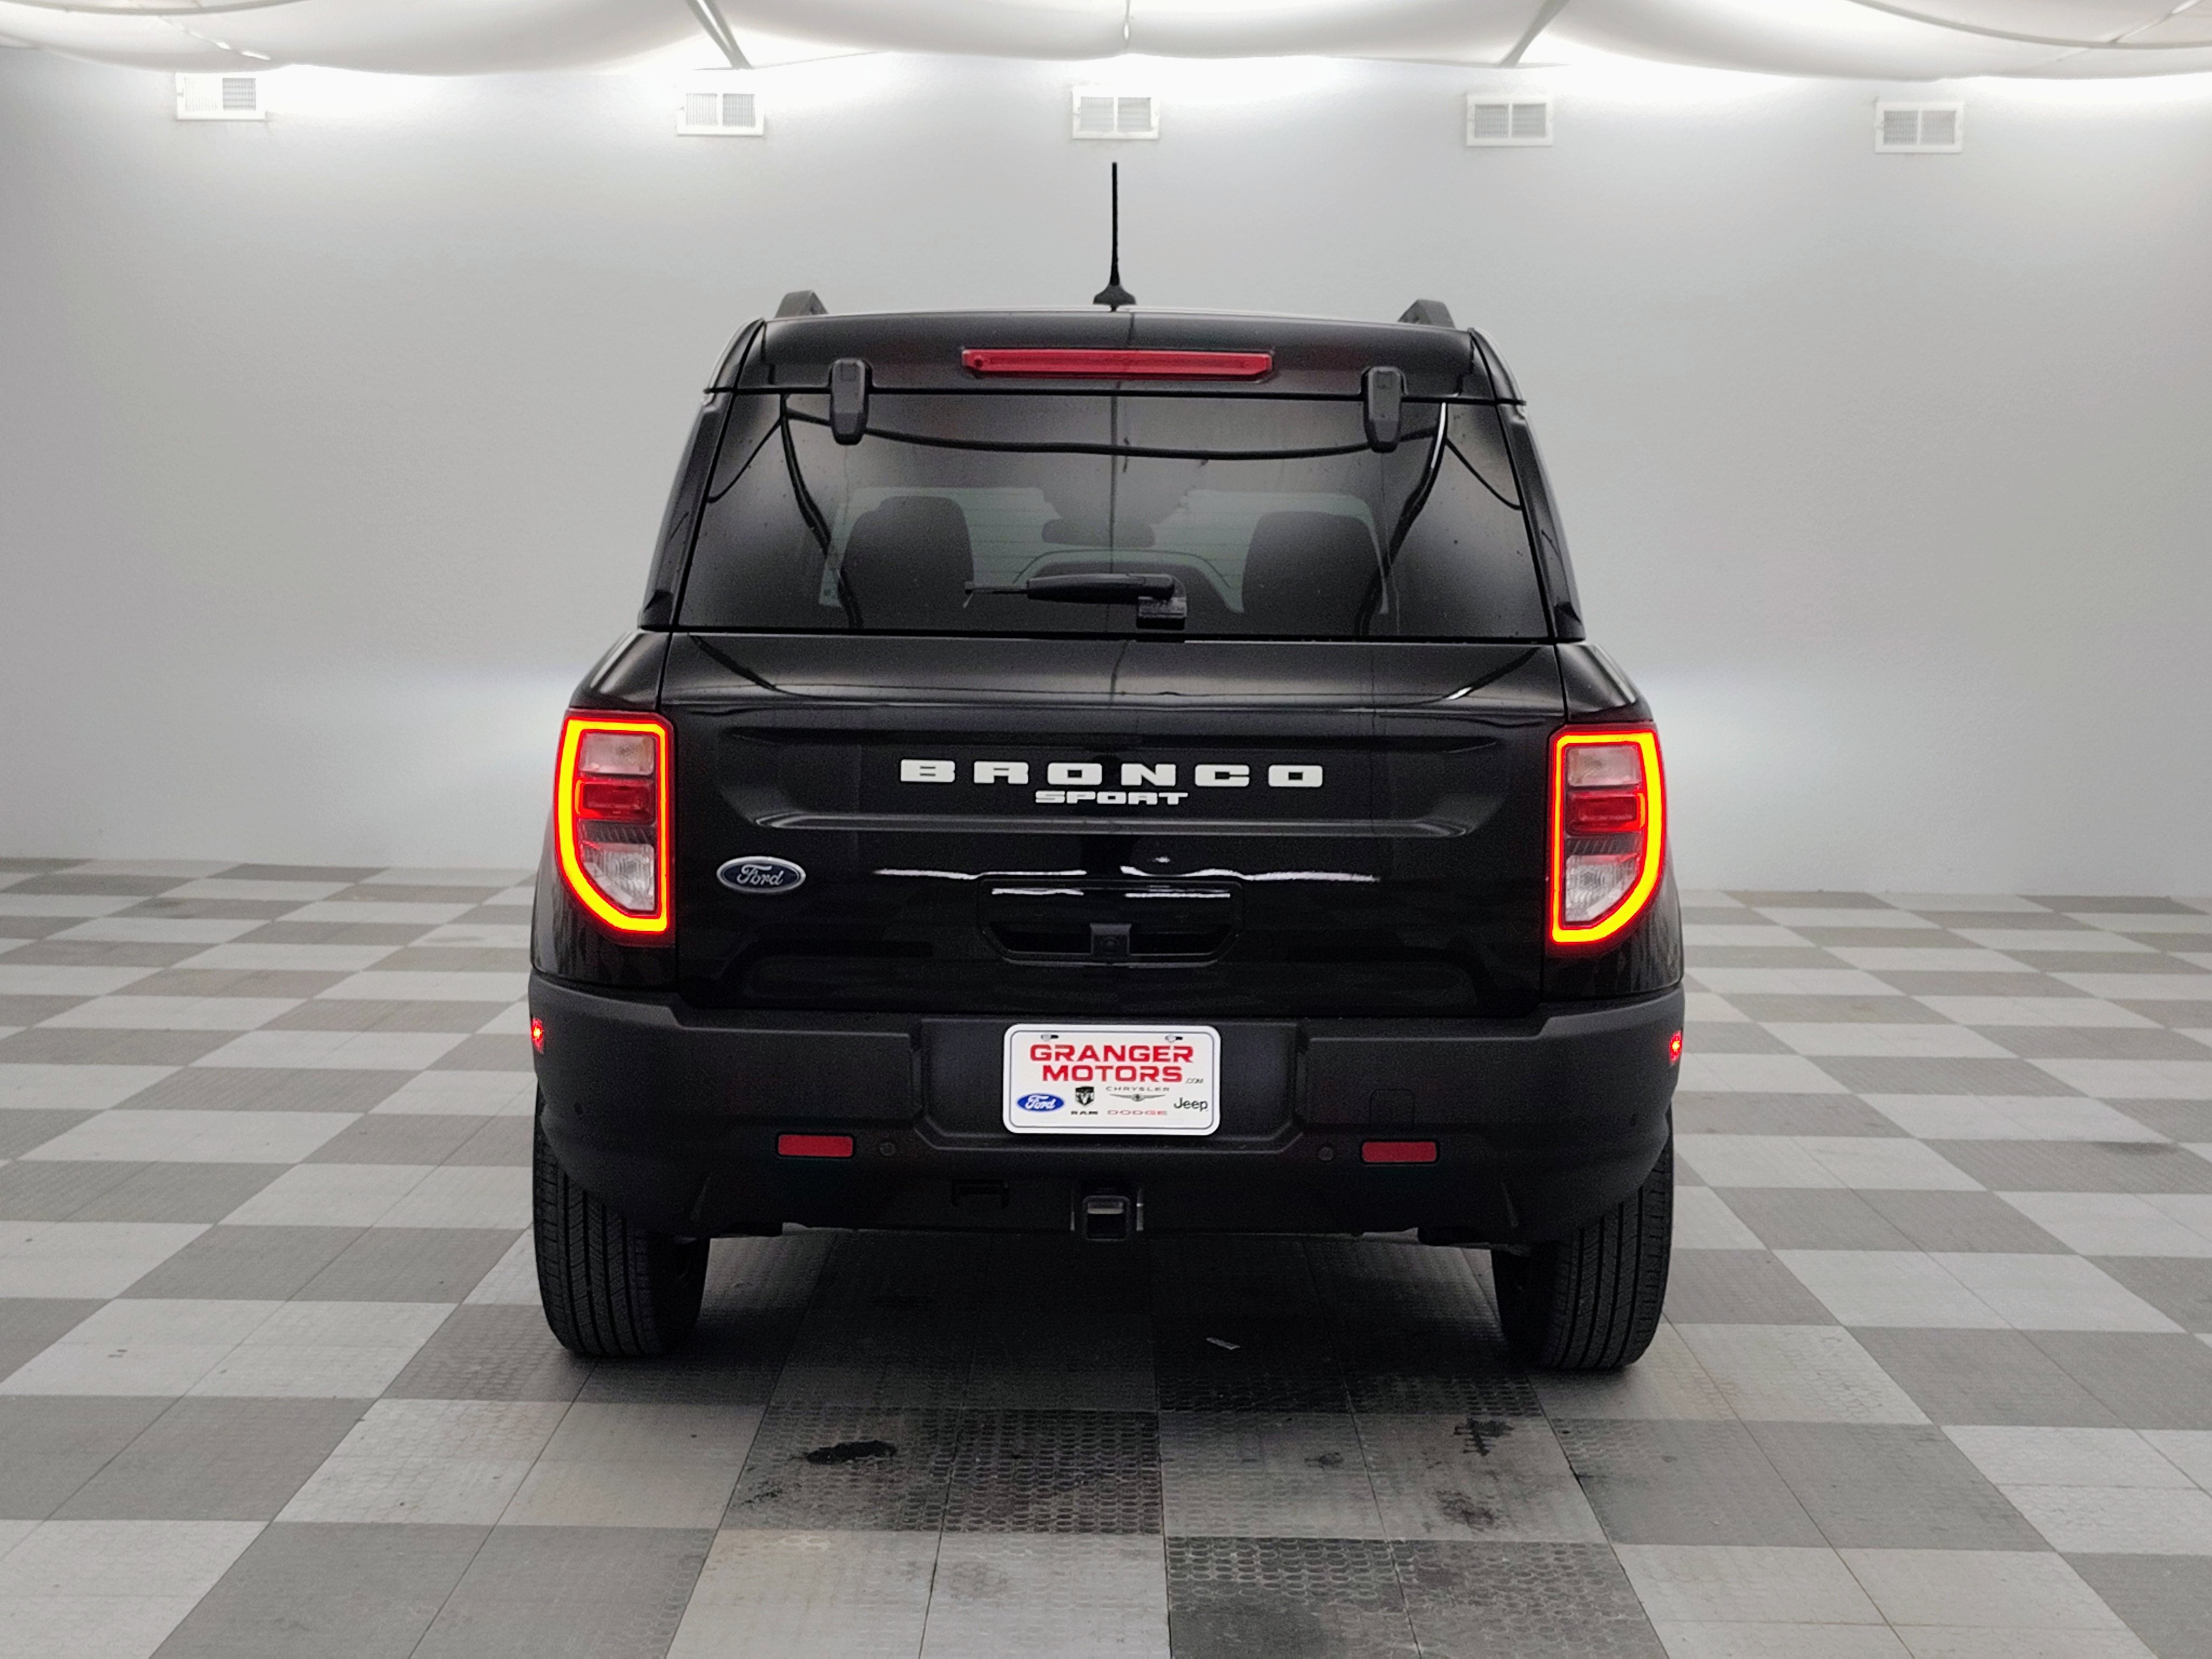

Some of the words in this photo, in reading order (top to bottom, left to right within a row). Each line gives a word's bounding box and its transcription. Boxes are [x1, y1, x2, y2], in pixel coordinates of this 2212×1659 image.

[900, 759, 1324, 787] BRONCO
[1035, 790, 1188, 805] SPORT
[736, 864, 784, 886] Ford
[1030, 1044, 1194, 1063] GRANGER
[1042, 1064, 1183, 1083] MOTORS
[1024, 1094, 1056, 1110] Ford
[1174, 1097, 1208, 1112] Jeep
